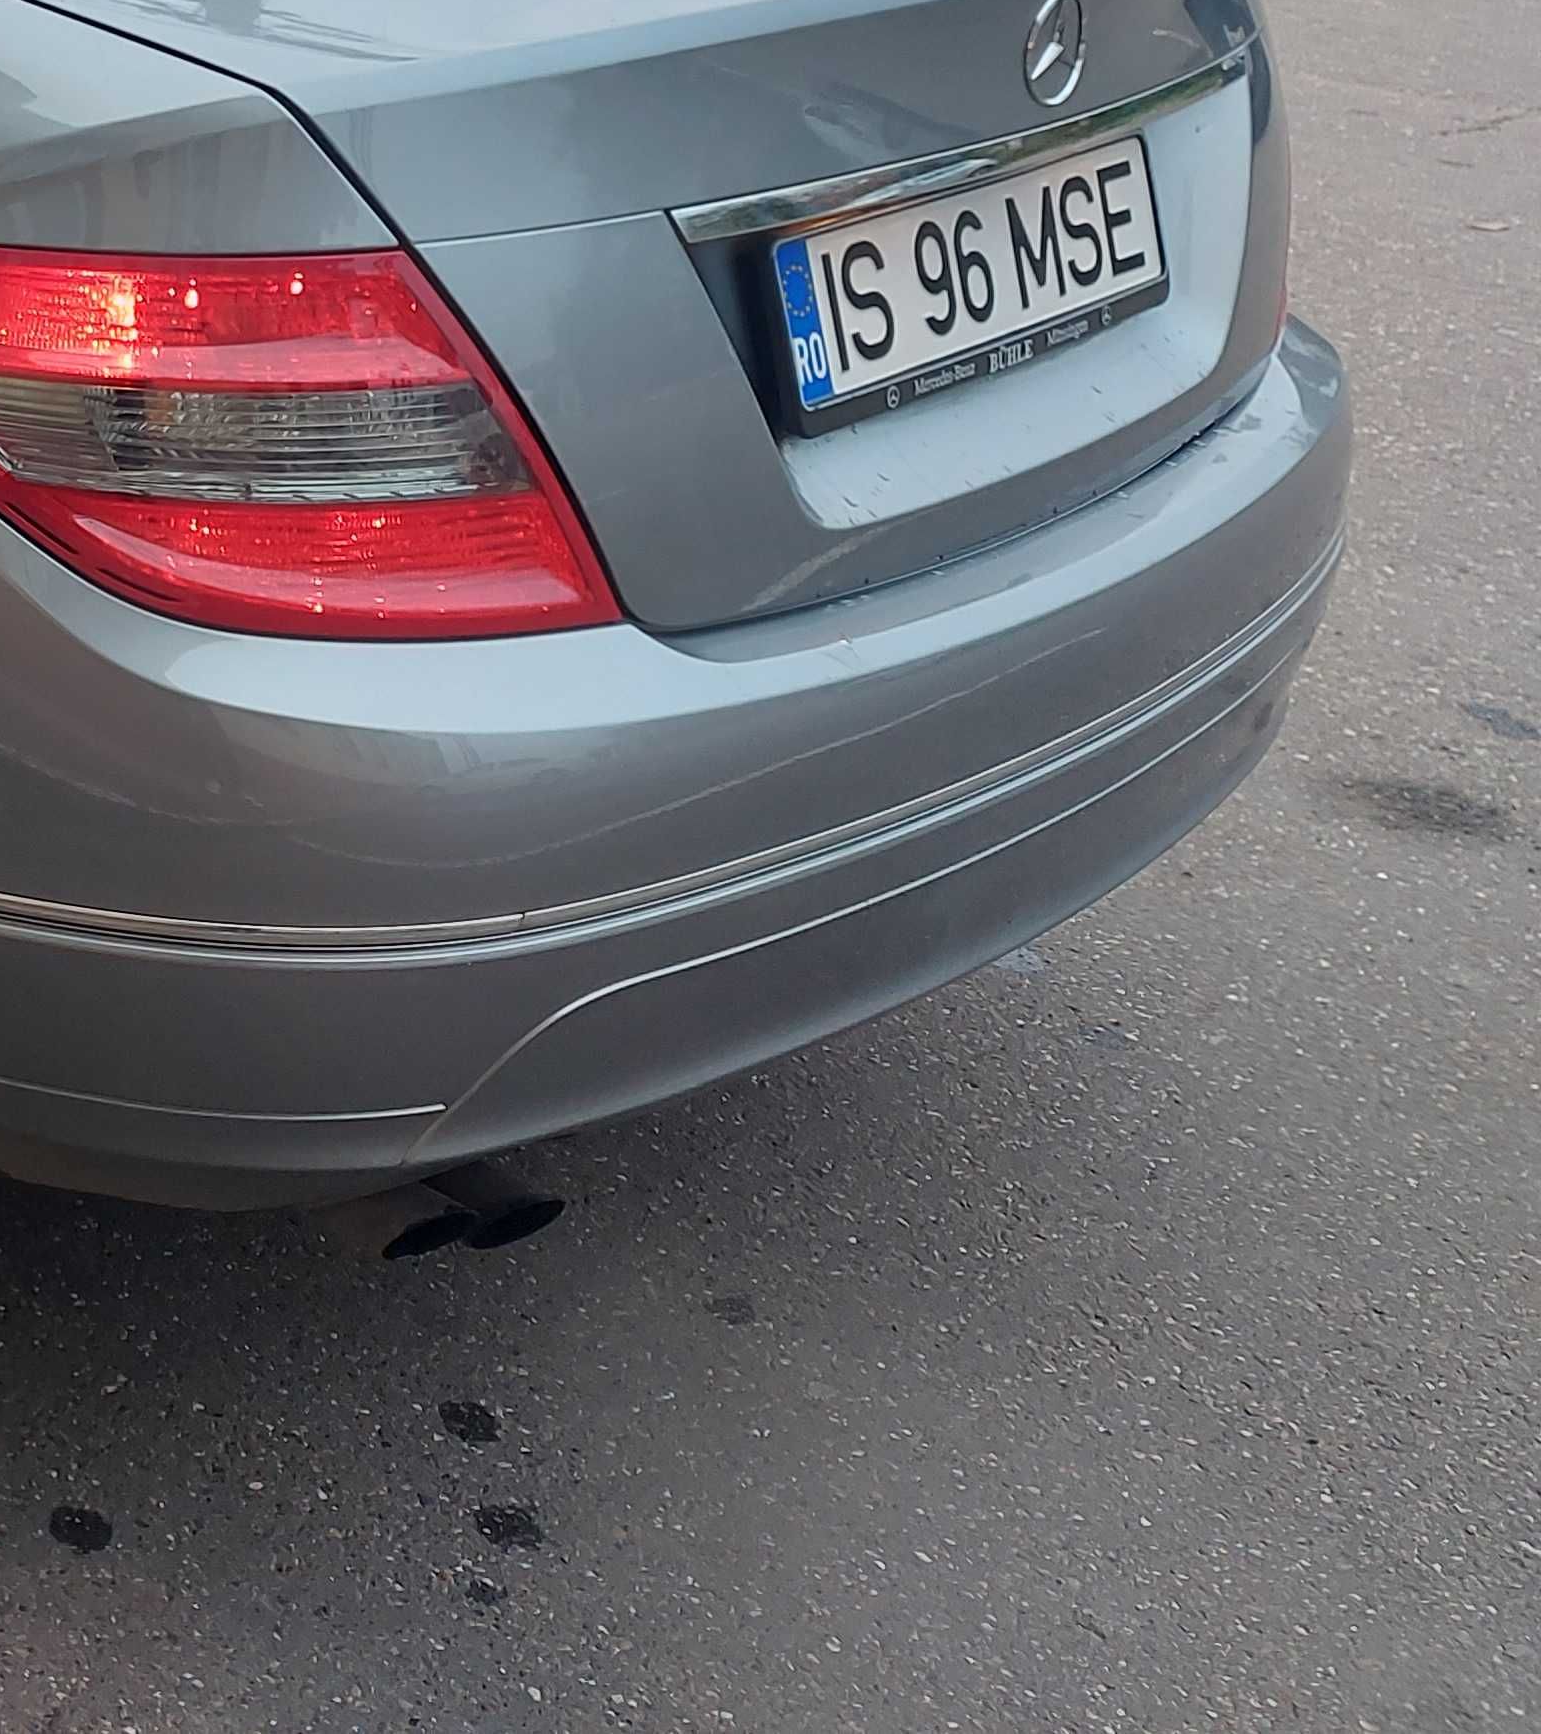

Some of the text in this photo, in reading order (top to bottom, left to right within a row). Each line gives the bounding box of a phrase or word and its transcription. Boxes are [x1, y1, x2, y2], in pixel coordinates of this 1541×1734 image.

[794, 160, 1146, 387] RO IS 96 MSE
[913, 362, 976, 397] Mercedes-Benz
[988, 338, 1035, 374] BÜHLE
